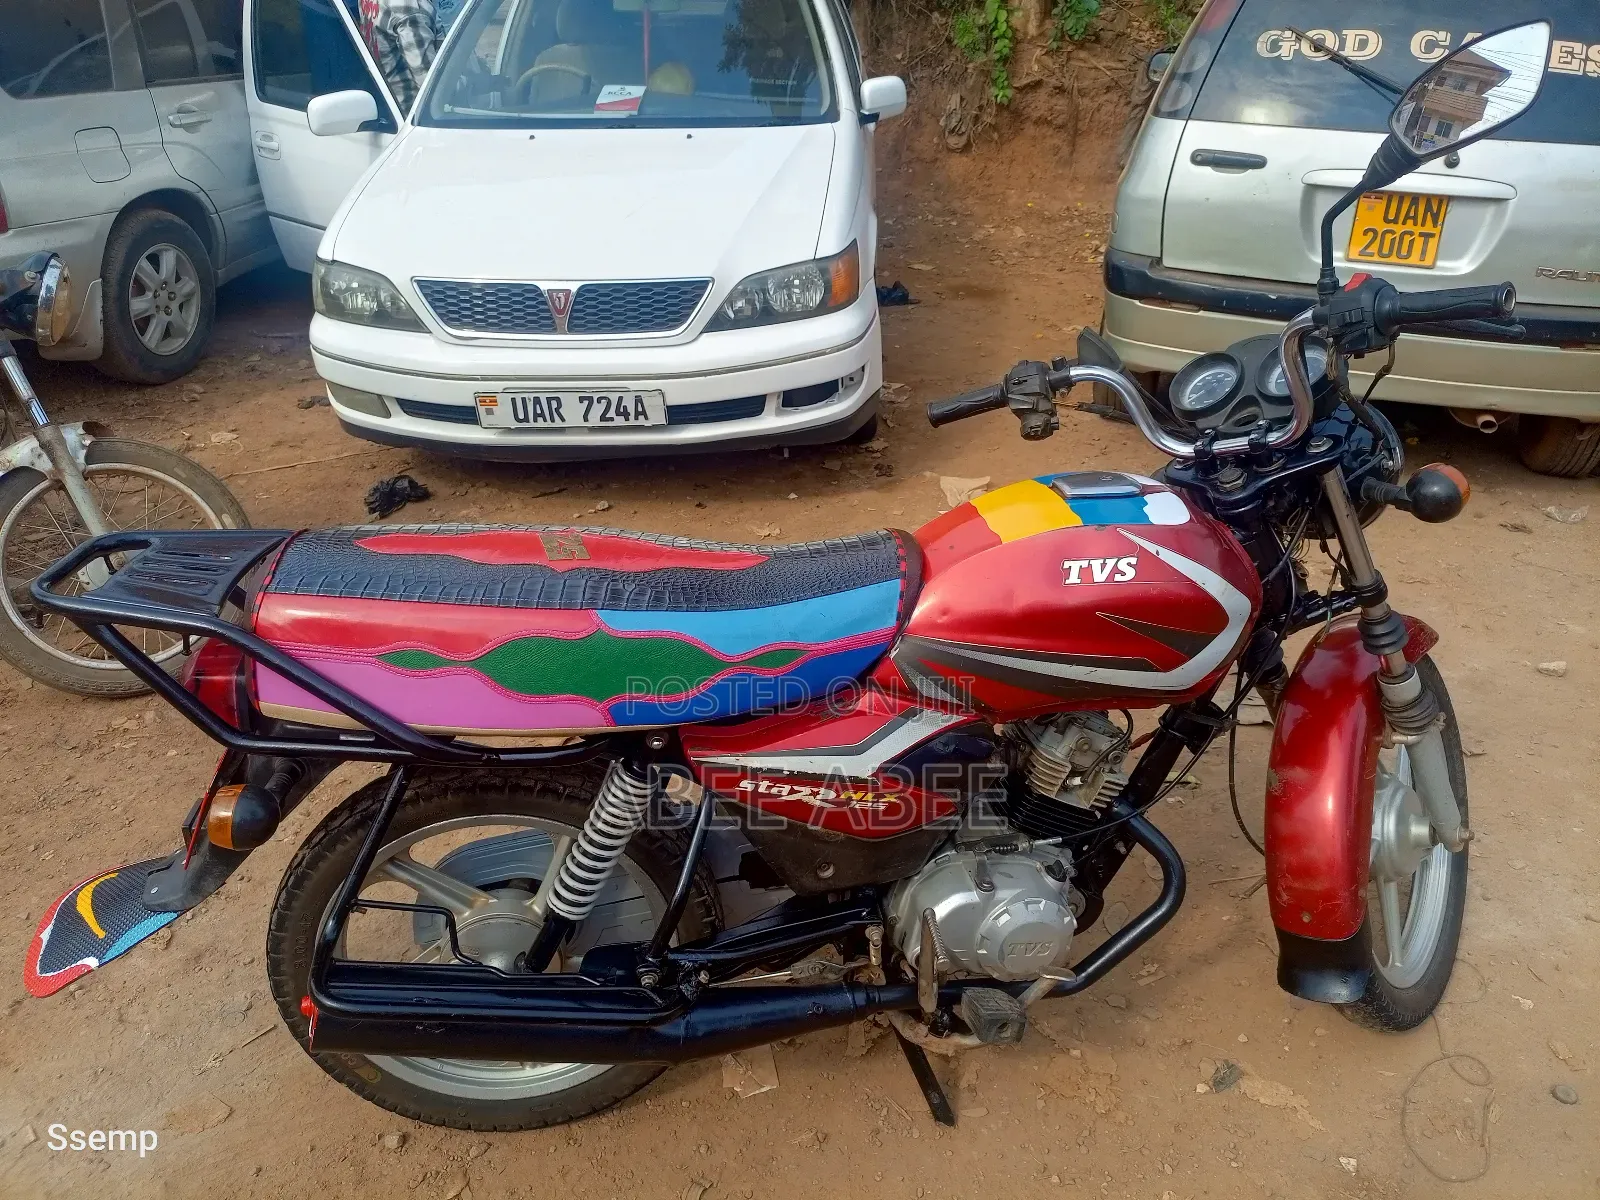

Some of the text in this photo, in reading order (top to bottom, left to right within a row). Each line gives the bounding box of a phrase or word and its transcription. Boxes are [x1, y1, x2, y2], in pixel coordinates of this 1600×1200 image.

[1256, 29, 1383, 61] GOD
[1383, 194, 1445, 228] UAN
[1358, 227, 1436, 262] 200T
[510, 394, 649, 424] UAR 724A
[1063, 557, 1137, 585] TVS
[1007, 940, 1053, 957] TVS
